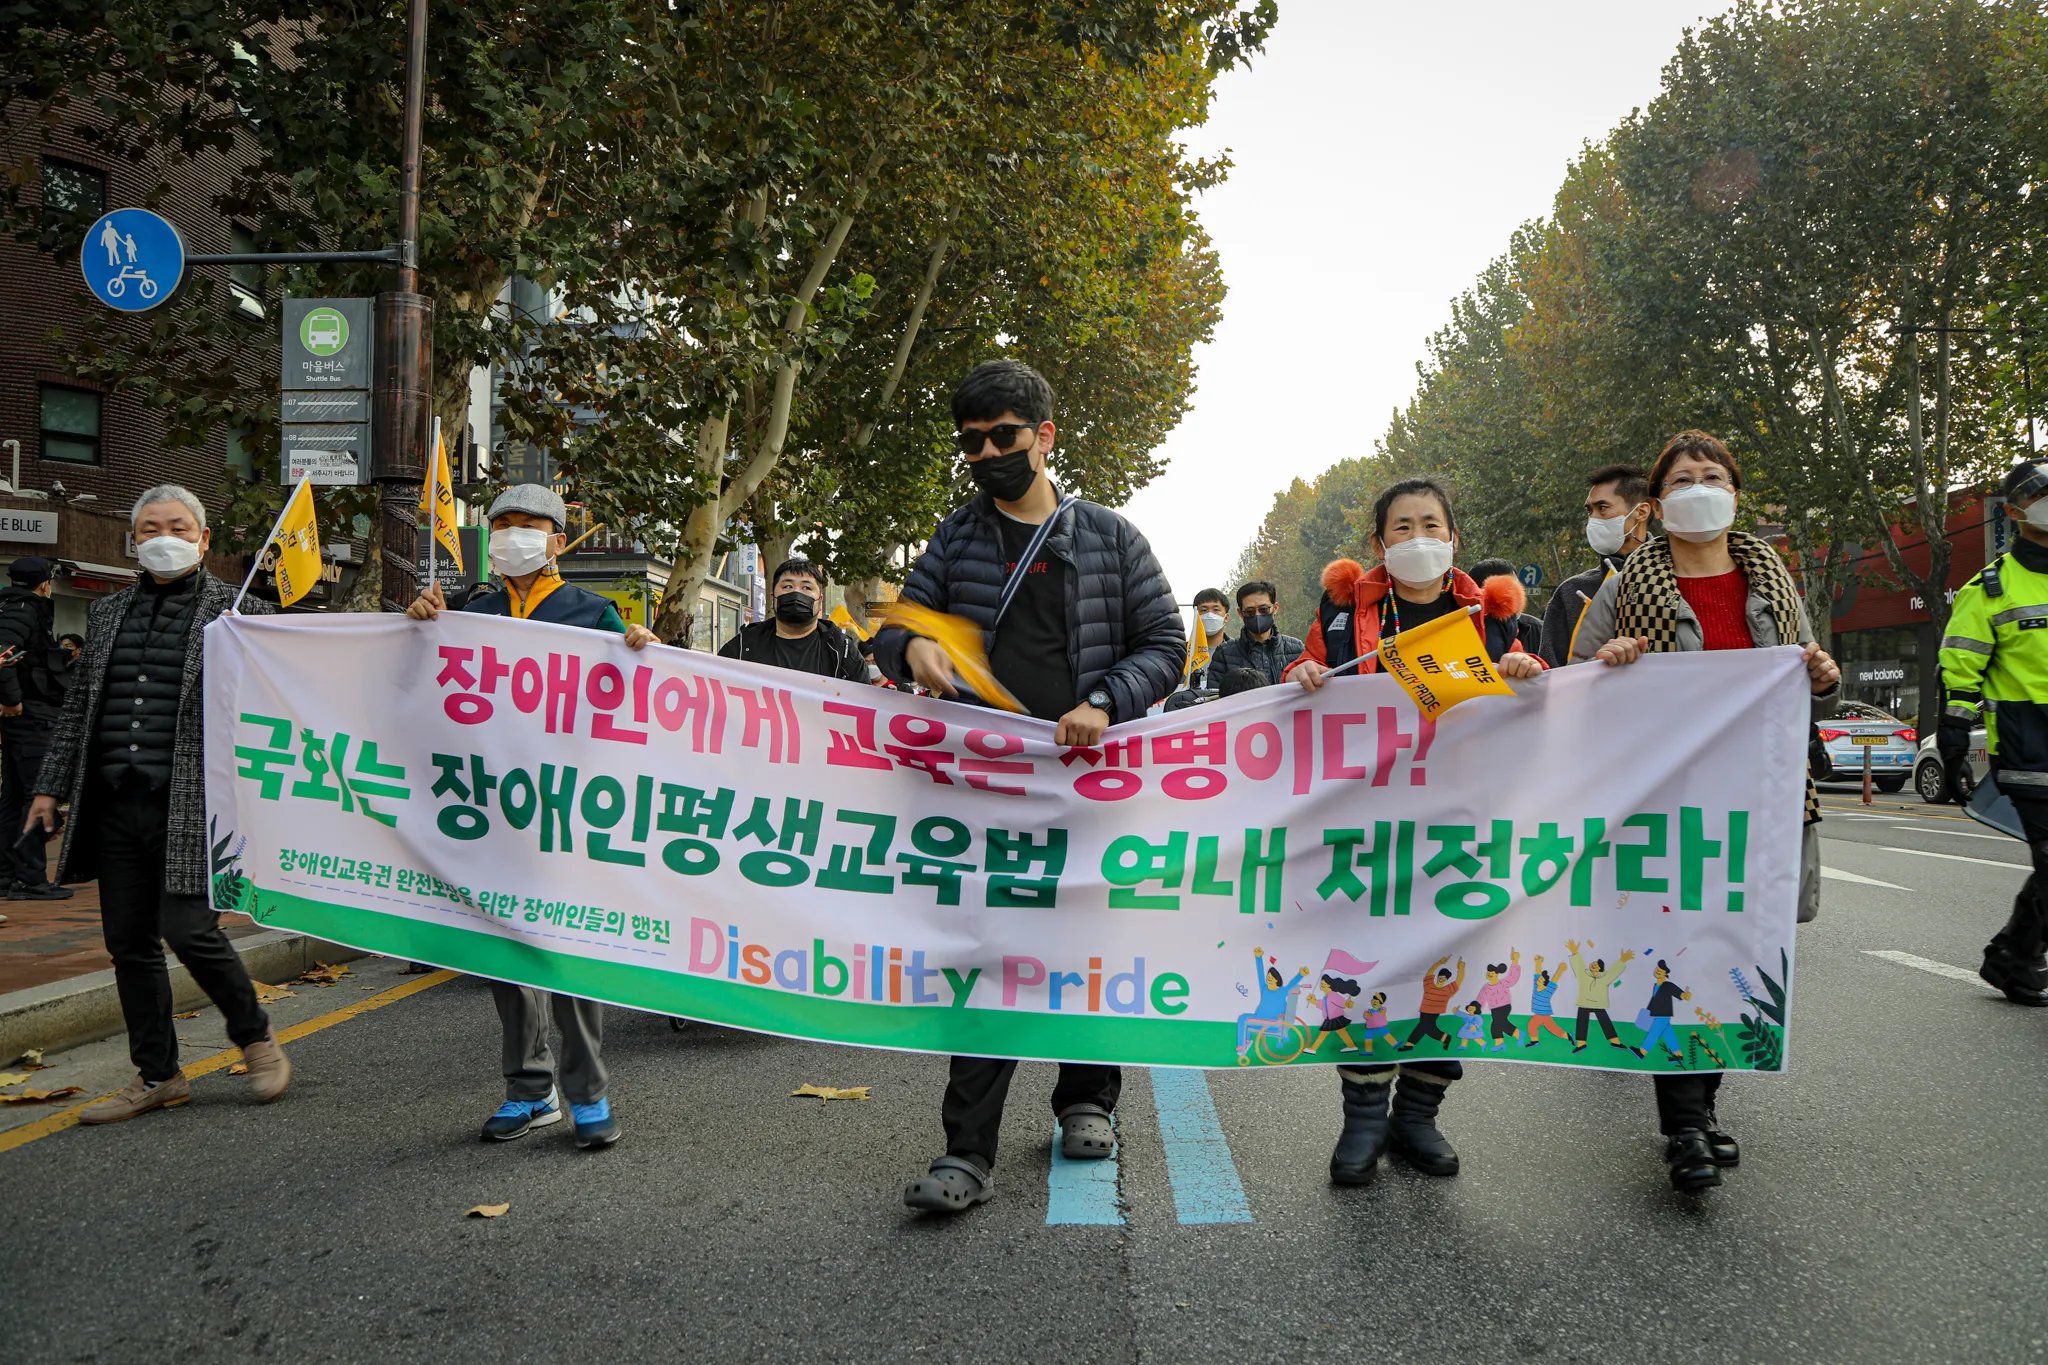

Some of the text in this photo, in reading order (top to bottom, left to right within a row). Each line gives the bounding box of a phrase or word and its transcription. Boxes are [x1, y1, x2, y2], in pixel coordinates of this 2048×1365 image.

[302, 360, 346, 373] 마을버스
[0, 518, 42, 533] E BLUE
[318, 563, 343, 584] NLY
[1028, 561, 1048, 574] LIFE
[279, 568, 294, 600] PRIDE
[1382, 634, 1441, 713] DISABILITY PRIDE
[1417, 653, 1443, 675] 이다
[1859, 668, 1905, 682] new balance
[436, 645, 1437, 802] 장애인에게 교육은 생명이다!
[234, 712, 1750, 920] 국회는 장애인평생교육법 연내 제정하라!
[279, 848, 671, 945] 장애인교육권 완전보장을 위한 장애인들의 행진
[687, 916, 1190, 1016] Disability Pride
